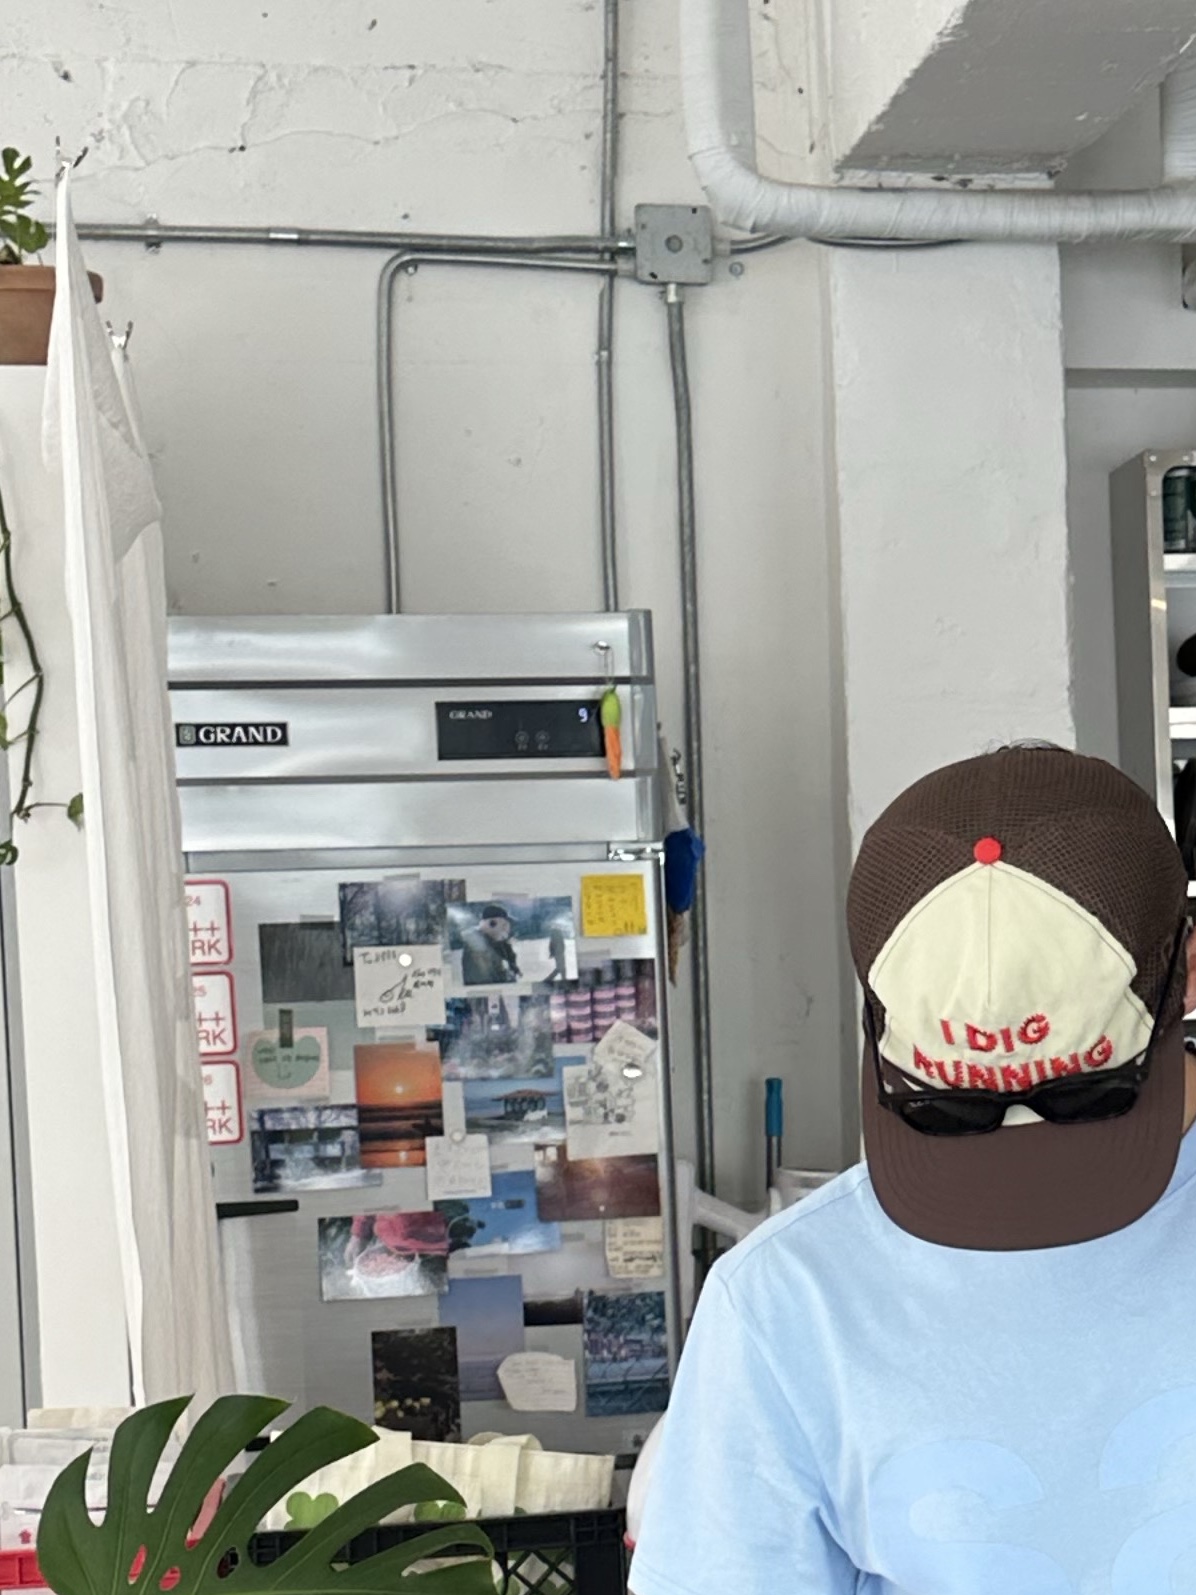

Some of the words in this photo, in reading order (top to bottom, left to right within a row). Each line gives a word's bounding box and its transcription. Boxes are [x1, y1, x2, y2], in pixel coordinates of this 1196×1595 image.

[198, 726, 283, 743] GRAND
[940, 1019, 955, 1046] I
[965, 1012, 1050, 1054] DIG
